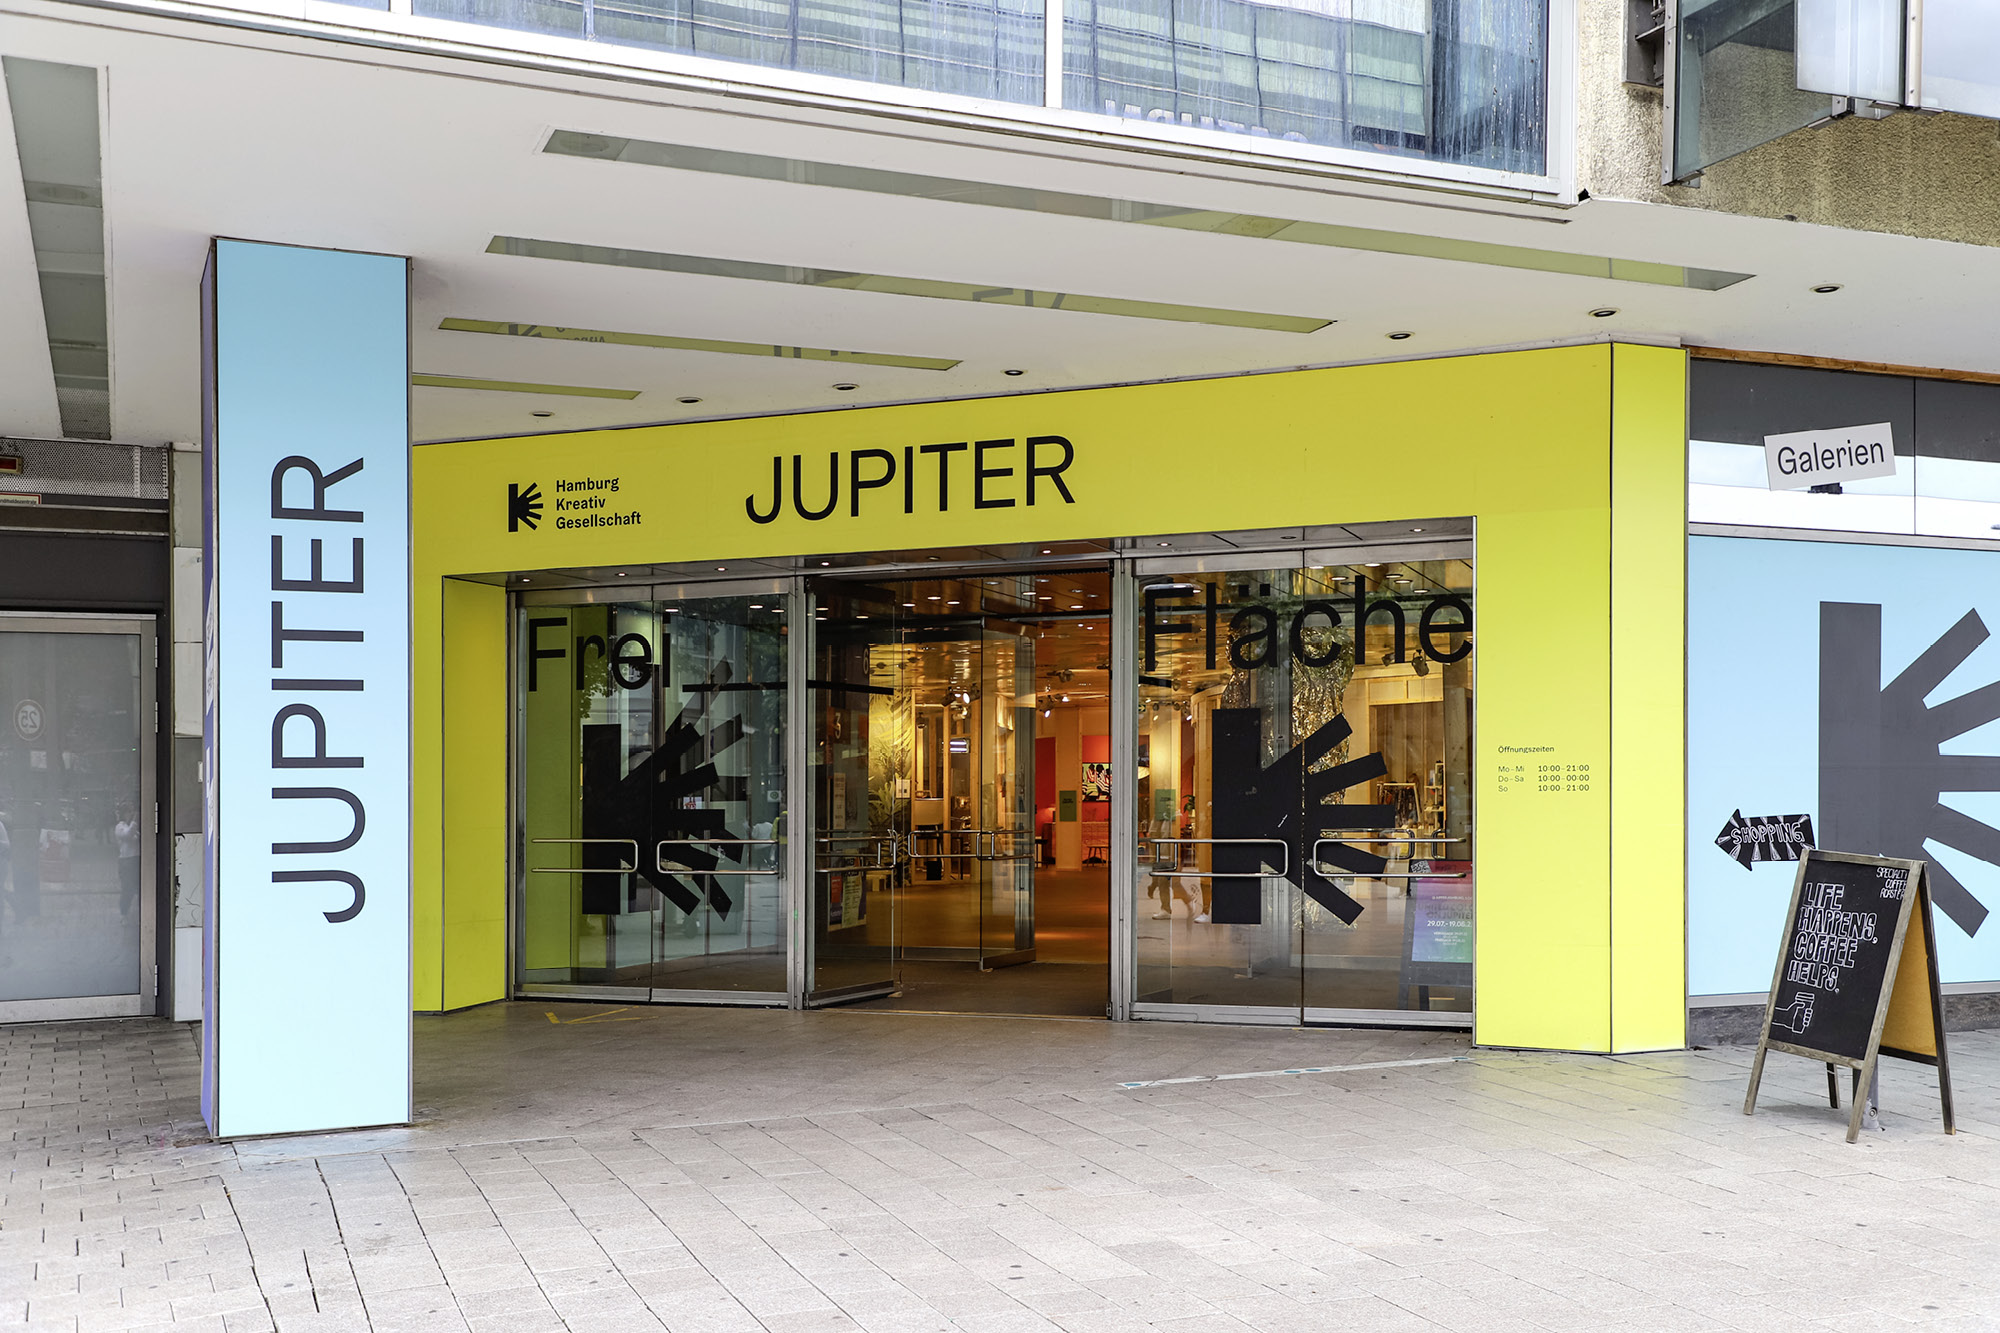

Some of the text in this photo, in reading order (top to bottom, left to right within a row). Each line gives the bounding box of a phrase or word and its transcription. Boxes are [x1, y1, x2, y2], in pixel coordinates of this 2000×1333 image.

[1777, 439, 1885, 475] Galerien
[555, 477, 620, 493] Hamburg
[745, 435, 1076, 525] JUPITER
[555, 495, 606, 510] Kreativ
[555, 510, 642, 530] Gesellschaft
[528, 574, 1473, 692] Frei Fläche
[270, 455, 366, 924] JUPITER
[1497, 744, 1556, 754] Öffnungszeiten
[1730, 821, 1806, 845] SHOPPING
[1803, 882, 1844, 910] LIFE
[1797, 906, 1878, 944] HAPPENS,
[1794, 931, 1858, 968] COFFEE
[1787, 960, 1840, 994] HELPS.
